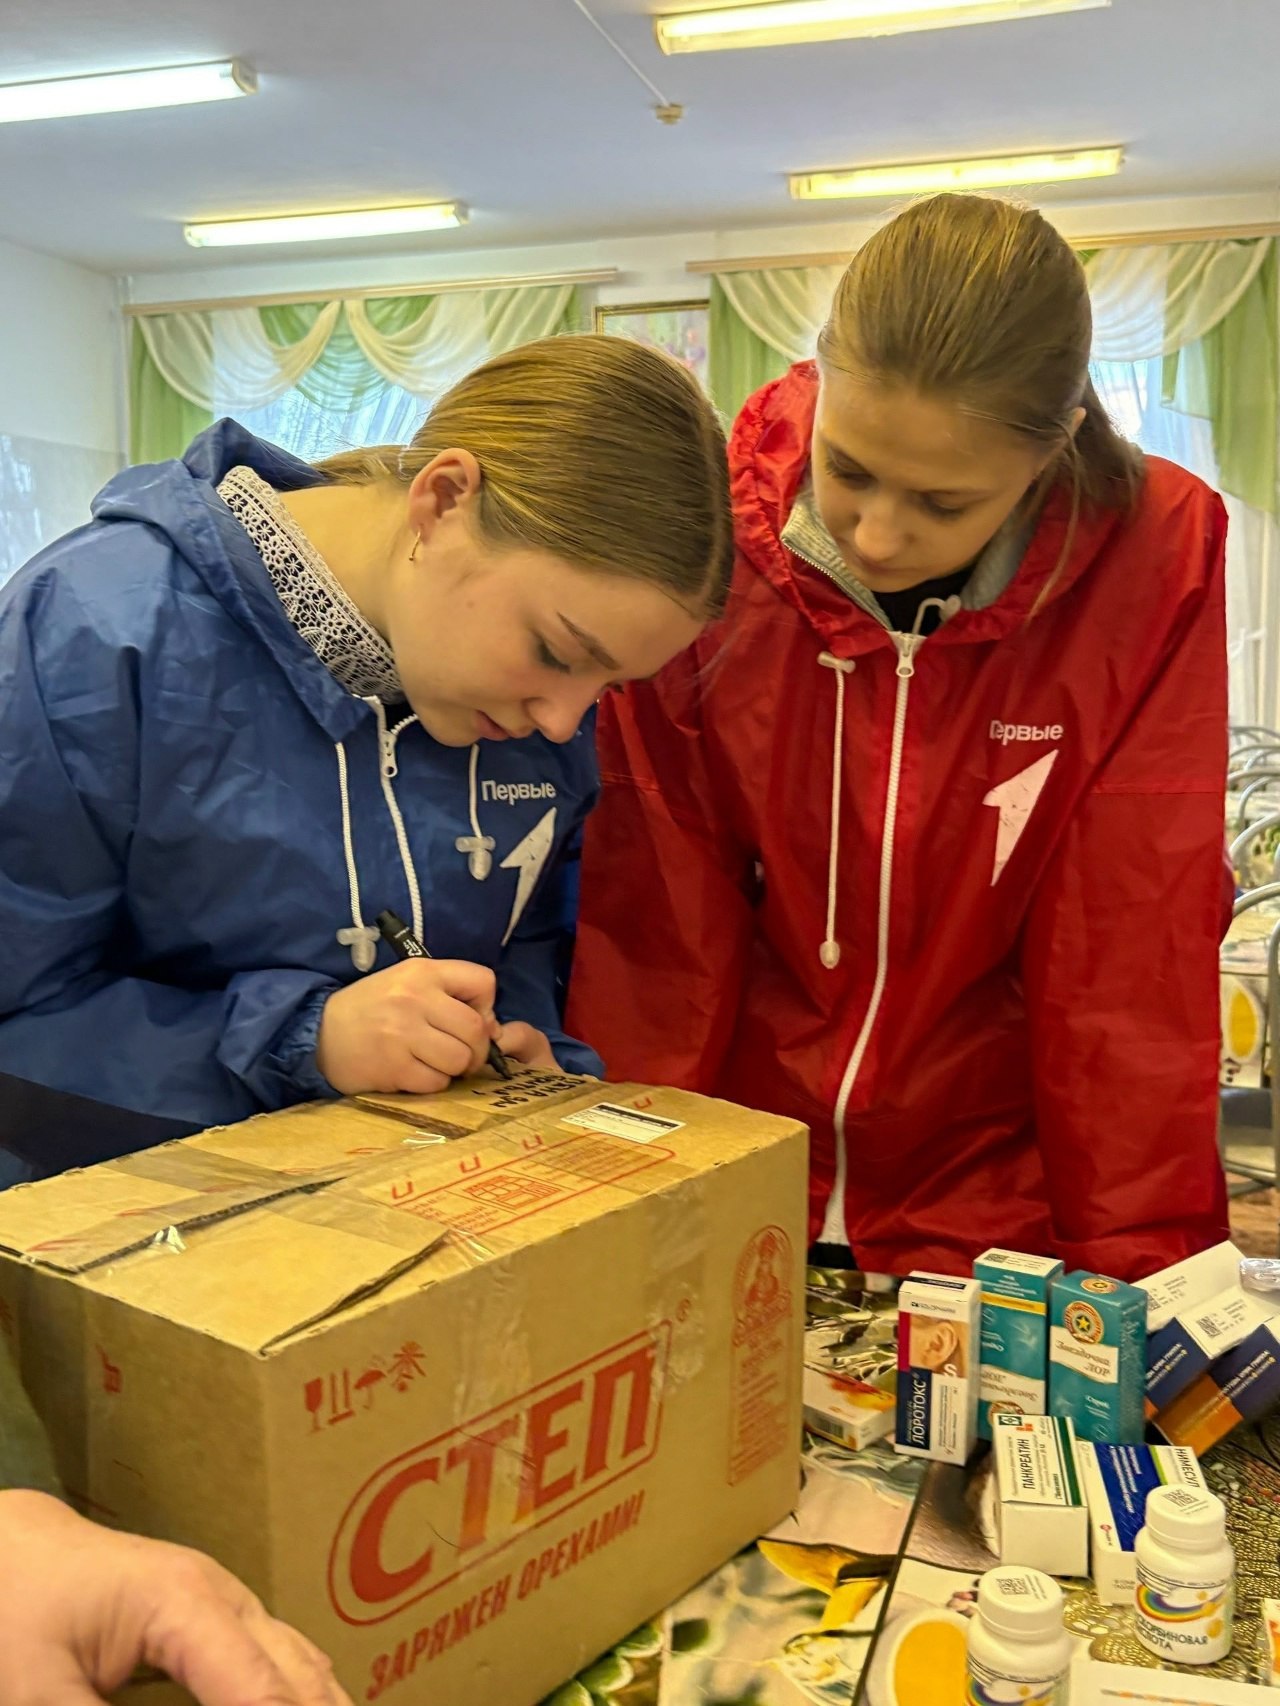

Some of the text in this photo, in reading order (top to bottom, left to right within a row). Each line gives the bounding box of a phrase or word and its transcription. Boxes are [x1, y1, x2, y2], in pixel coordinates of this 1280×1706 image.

[481, 779, 557, 806] Первые
[911, 1380, 927, 1445] ЛОРОТОКС
[347, 1346, 657, 1604] СТЕП
[1017, 1439, 1036, 1490] ПАНКРЕАТИН
[365, 1488, 646, 1702] ЗАРЯЖЕН ОРЕХАМИ!
[1135, 1611, 1209, 1645] СКОРБИНОВАЯ
